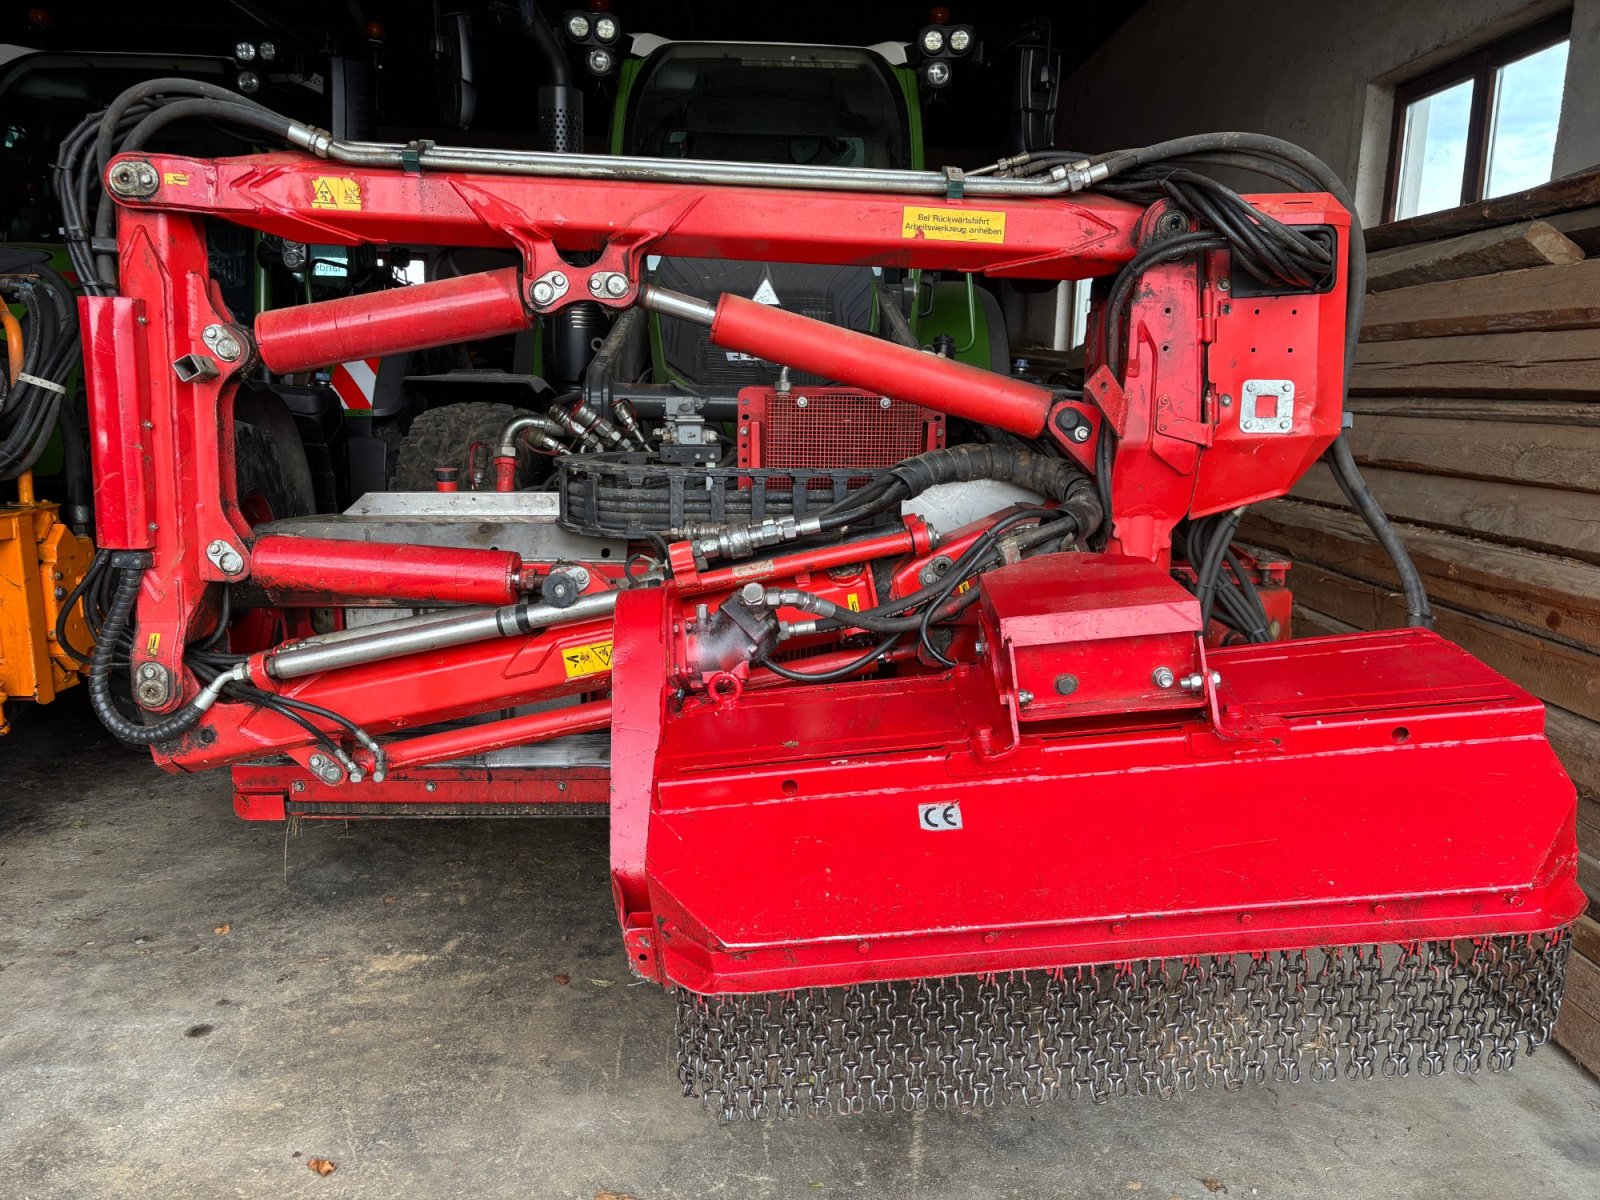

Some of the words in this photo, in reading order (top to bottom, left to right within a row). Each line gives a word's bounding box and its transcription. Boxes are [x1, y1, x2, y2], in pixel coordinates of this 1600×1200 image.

[918, 213, 930, 222] Bei
[933, 214, 990, 226] Rückwärtsfahrt
[905, 222, 967, 235] Arbeitswerkzeug
[969, 226, 1002, 236] anheben
[924, 805, 957, 828] CE
